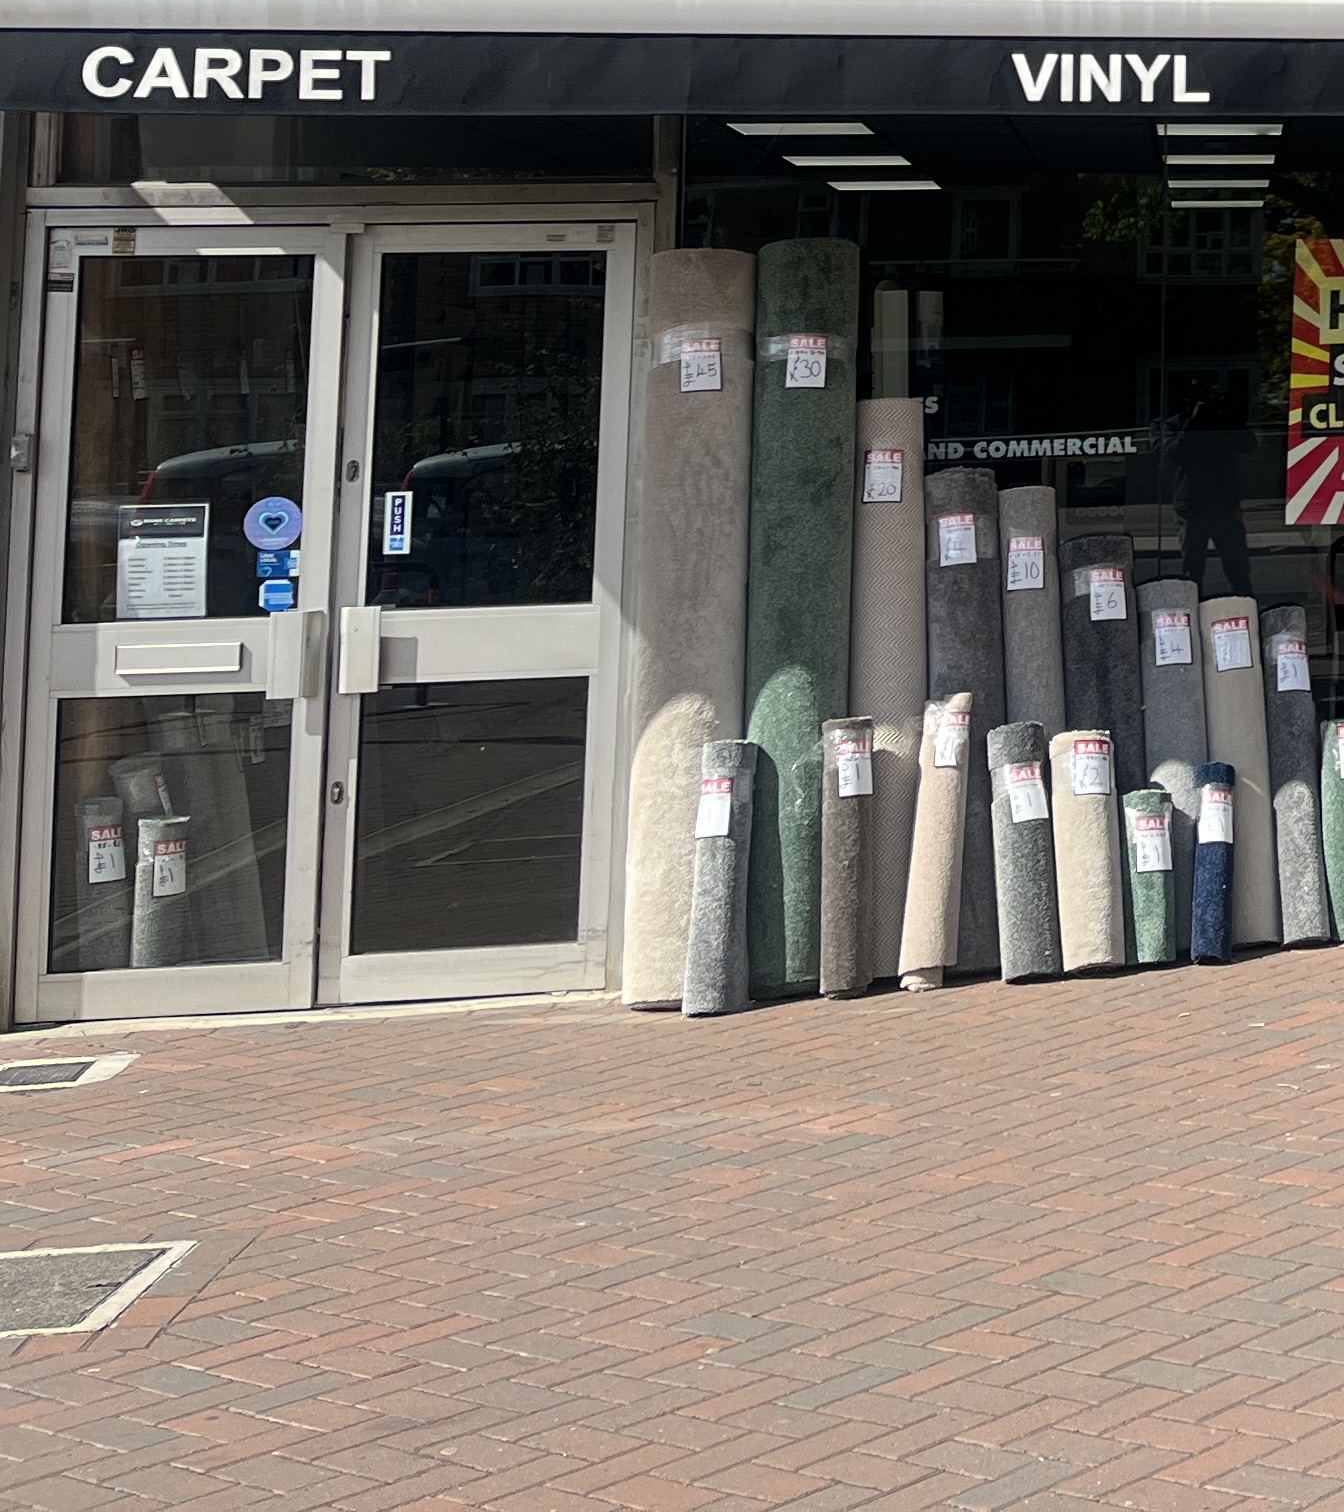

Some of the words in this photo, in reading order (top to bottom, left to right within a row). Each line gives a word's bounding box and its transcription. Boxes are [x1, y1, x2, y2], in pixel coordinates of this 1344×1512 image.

[81, 44, 392, 102] CARPET
[1010, 52, 1212, 104] VINYL
[681, 340, 720, 352] SALE
[790, 337, 826, 349] SALE
[924, 441, 965, 460] ND
[972, 436, 1138, 460] COMMERCIAL
[866, 452, 901, 464] SALE
[391, 497, 404, 534] PUSH
[938, 513, 974, 527] SALE
[1009, 538, 1043, 551] SALE
[1090, 570, 1124, 582] SALE
[1154, 616, 1190, 627] SALE
[1211, 618, 1249, 633] SALE
[1076, 741, 1109, 754] SALE
